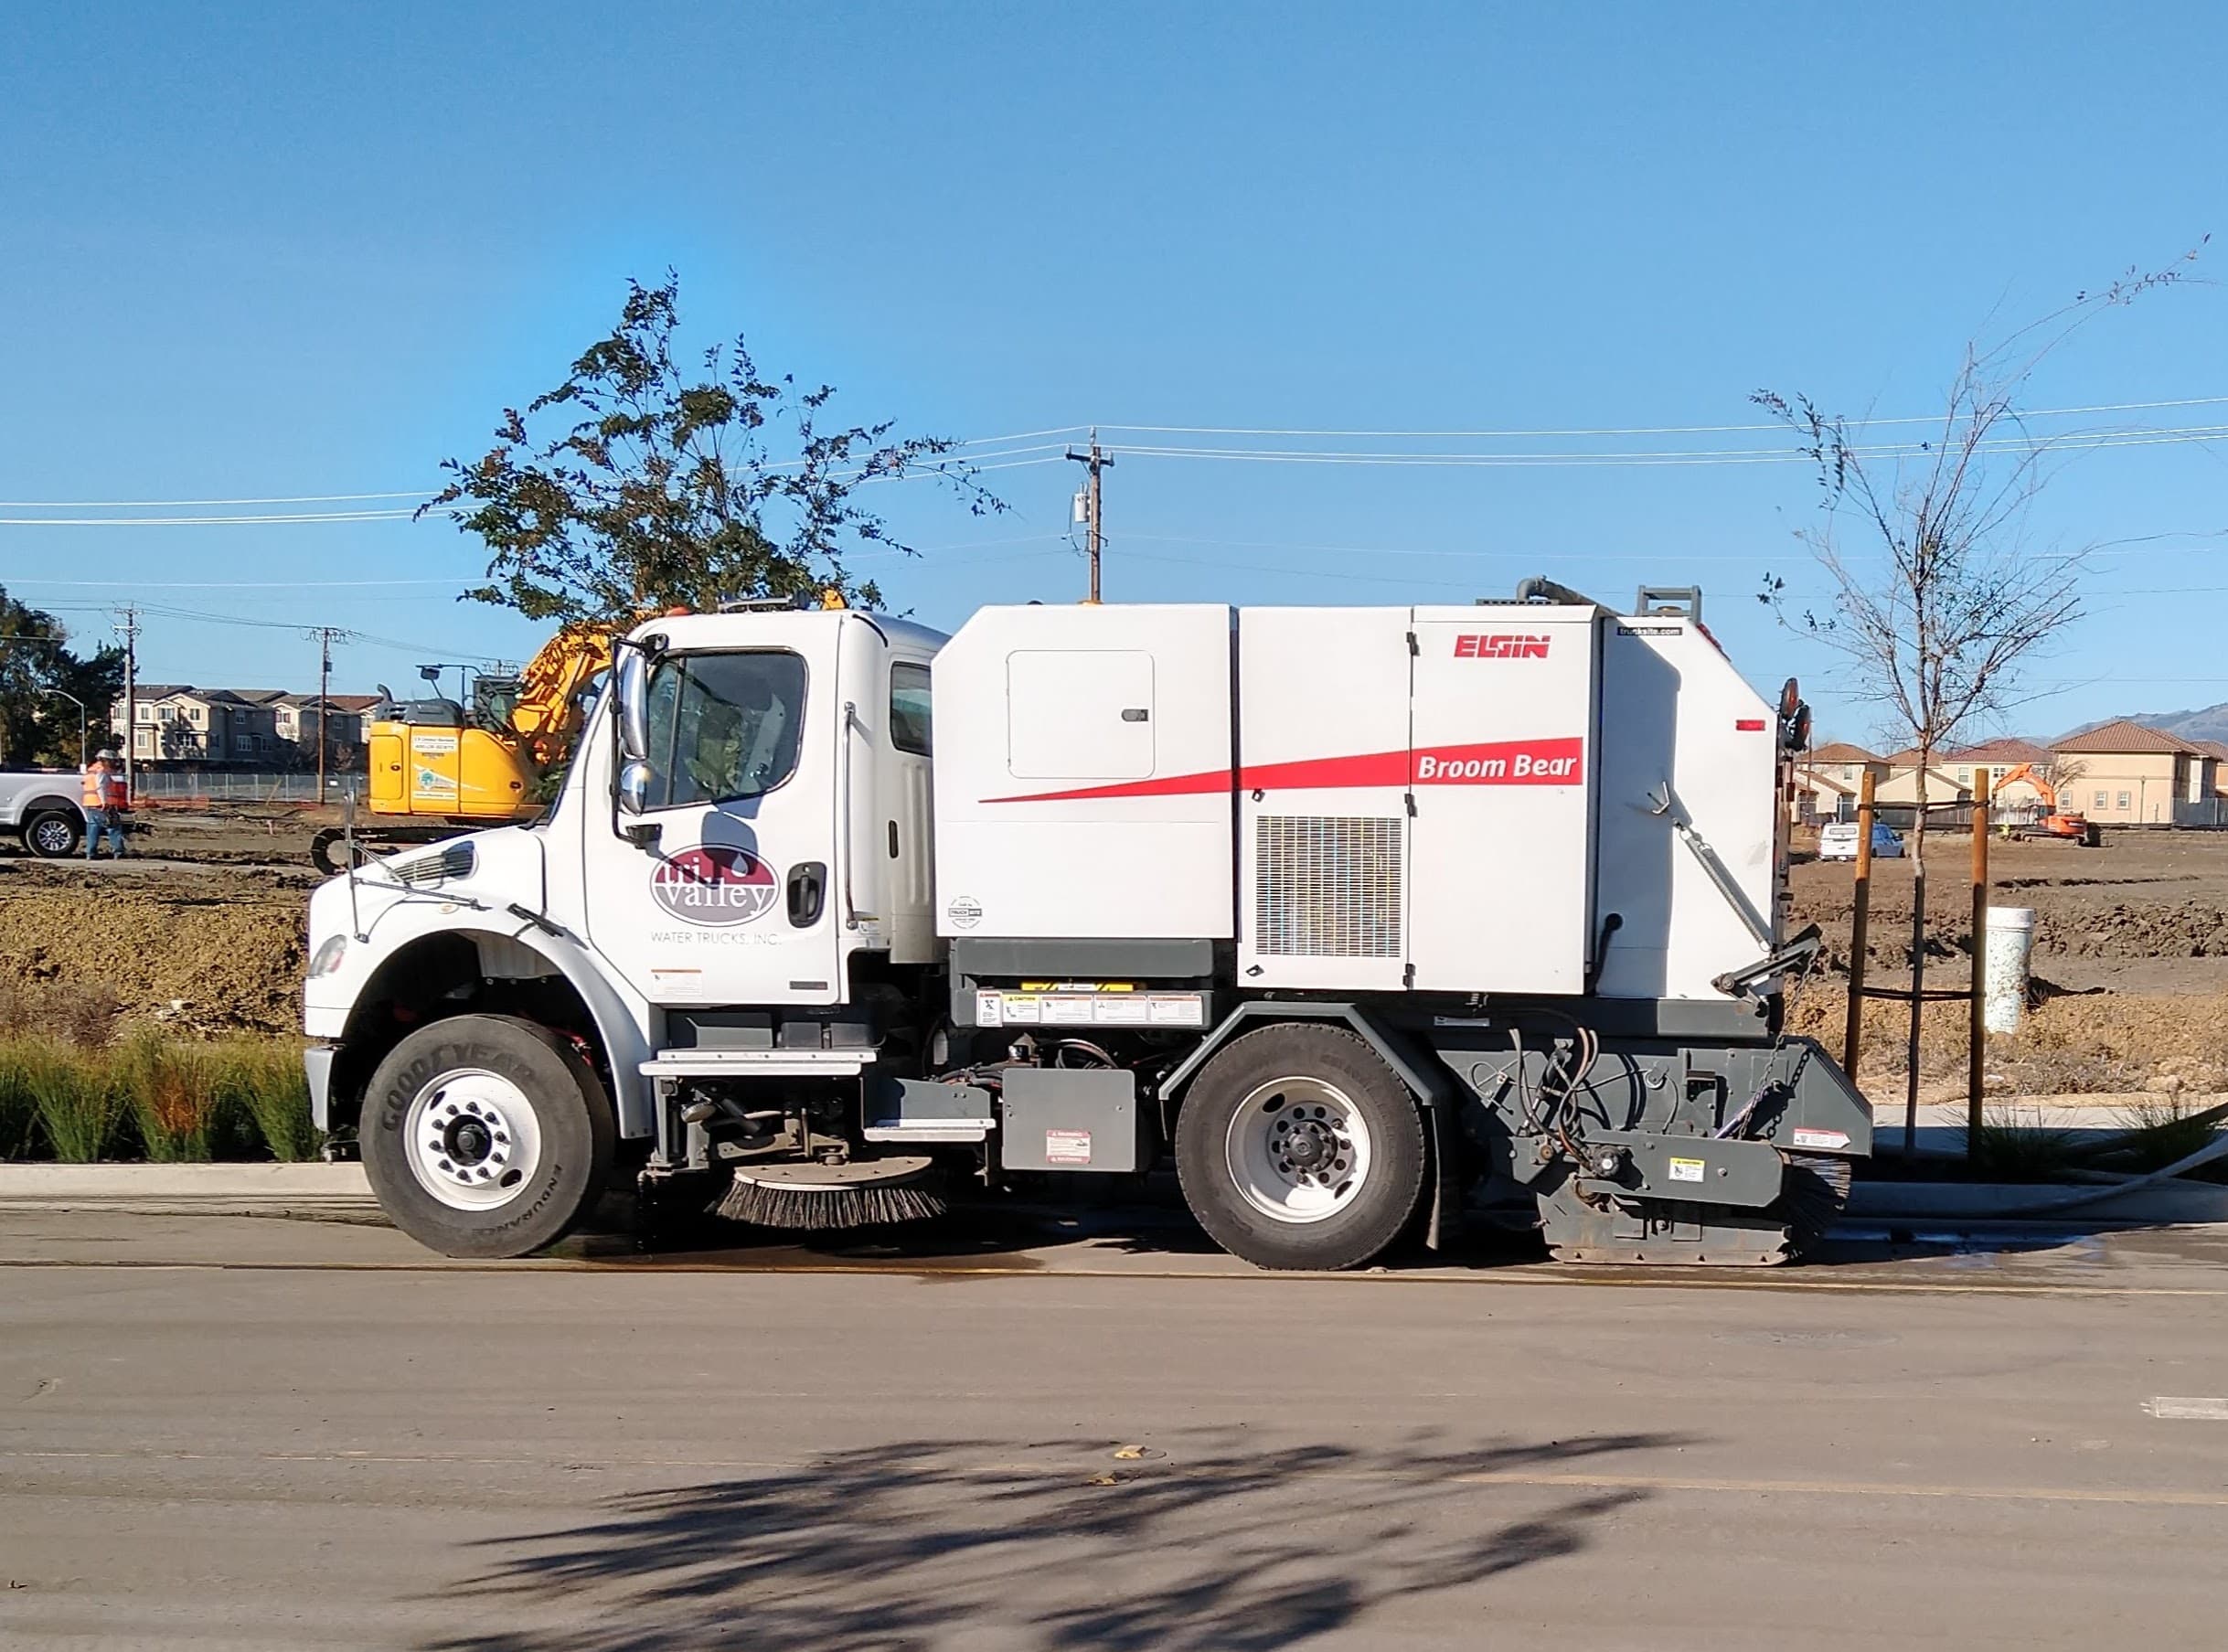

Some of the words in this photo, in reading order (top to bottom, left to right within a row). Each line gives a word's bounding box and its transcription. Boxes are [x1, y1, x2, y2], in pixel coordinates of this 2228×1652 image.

[1454, 634, 1551, 659] ELGIN
[1418, 755, 1508, 780] Broom
[1513, 753, 1578, 778] Bear
[664, 856, 701, 884] tri
[664, 877, 769, 917] valley
[650, 932, 693, 944] WATER
[753, 933, 783, 945] INC.
[381, 1042, 538, 1133] GOODYEAR
[472, 1164, 563, 1236] ENDURANCE
